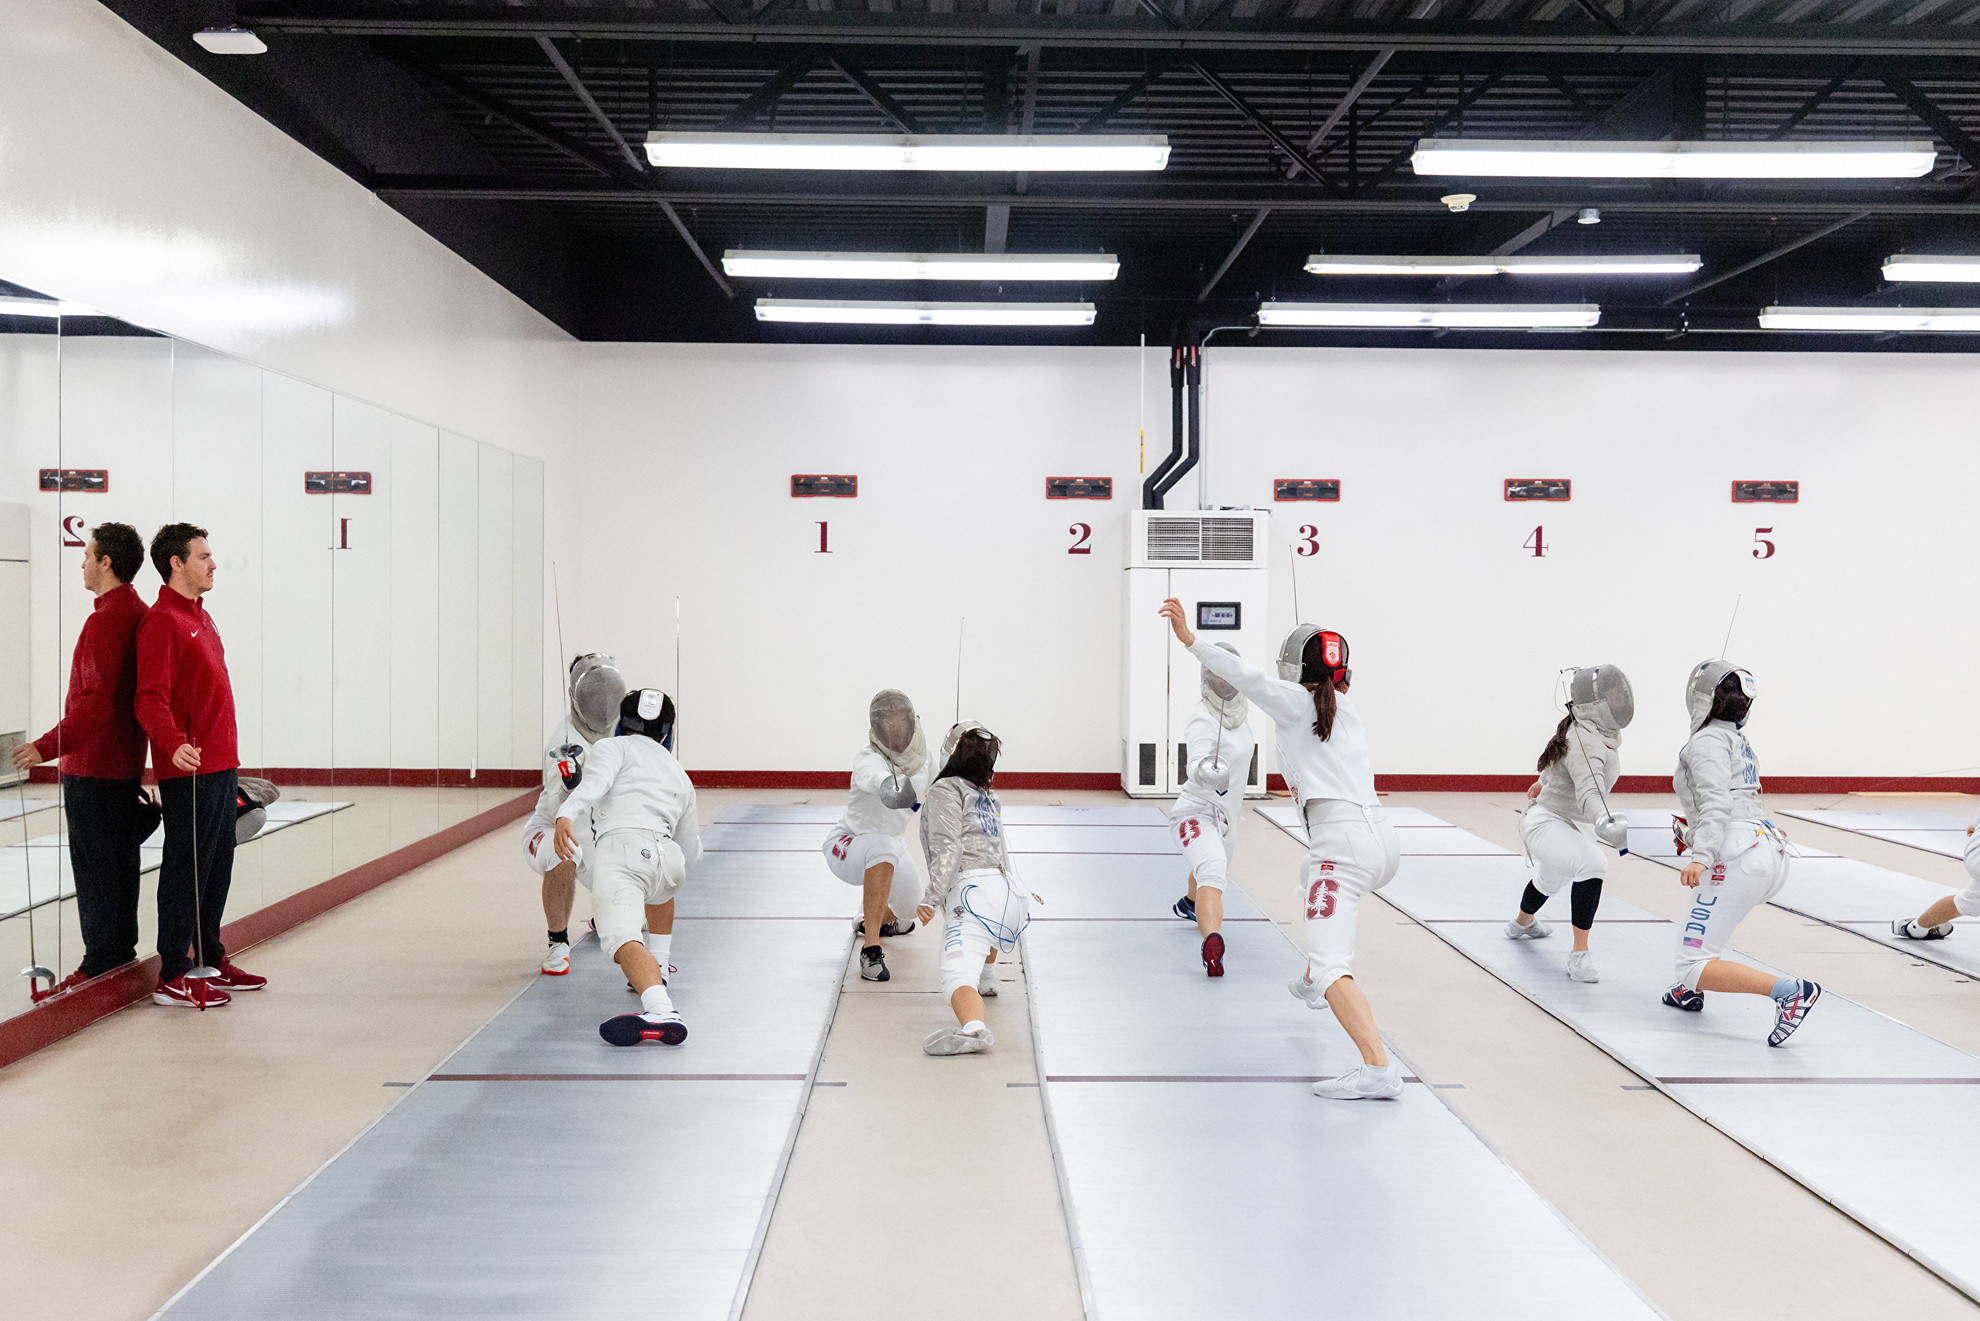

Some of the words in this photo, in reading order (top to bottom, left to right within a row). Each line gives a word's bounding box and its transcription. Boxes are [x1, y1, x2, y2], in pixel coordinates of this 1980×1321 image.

[814, 520, 833, 554] 1
[1067, 523, 1092, 555] 2
[1297, 524, 1321, 557] 3
[1522, 526, 1549, 558] 4
[1752, 527, 1776, 560] 5
[978, 811, 999, 838] USA
[1684, 893, 1718, 936] USA
